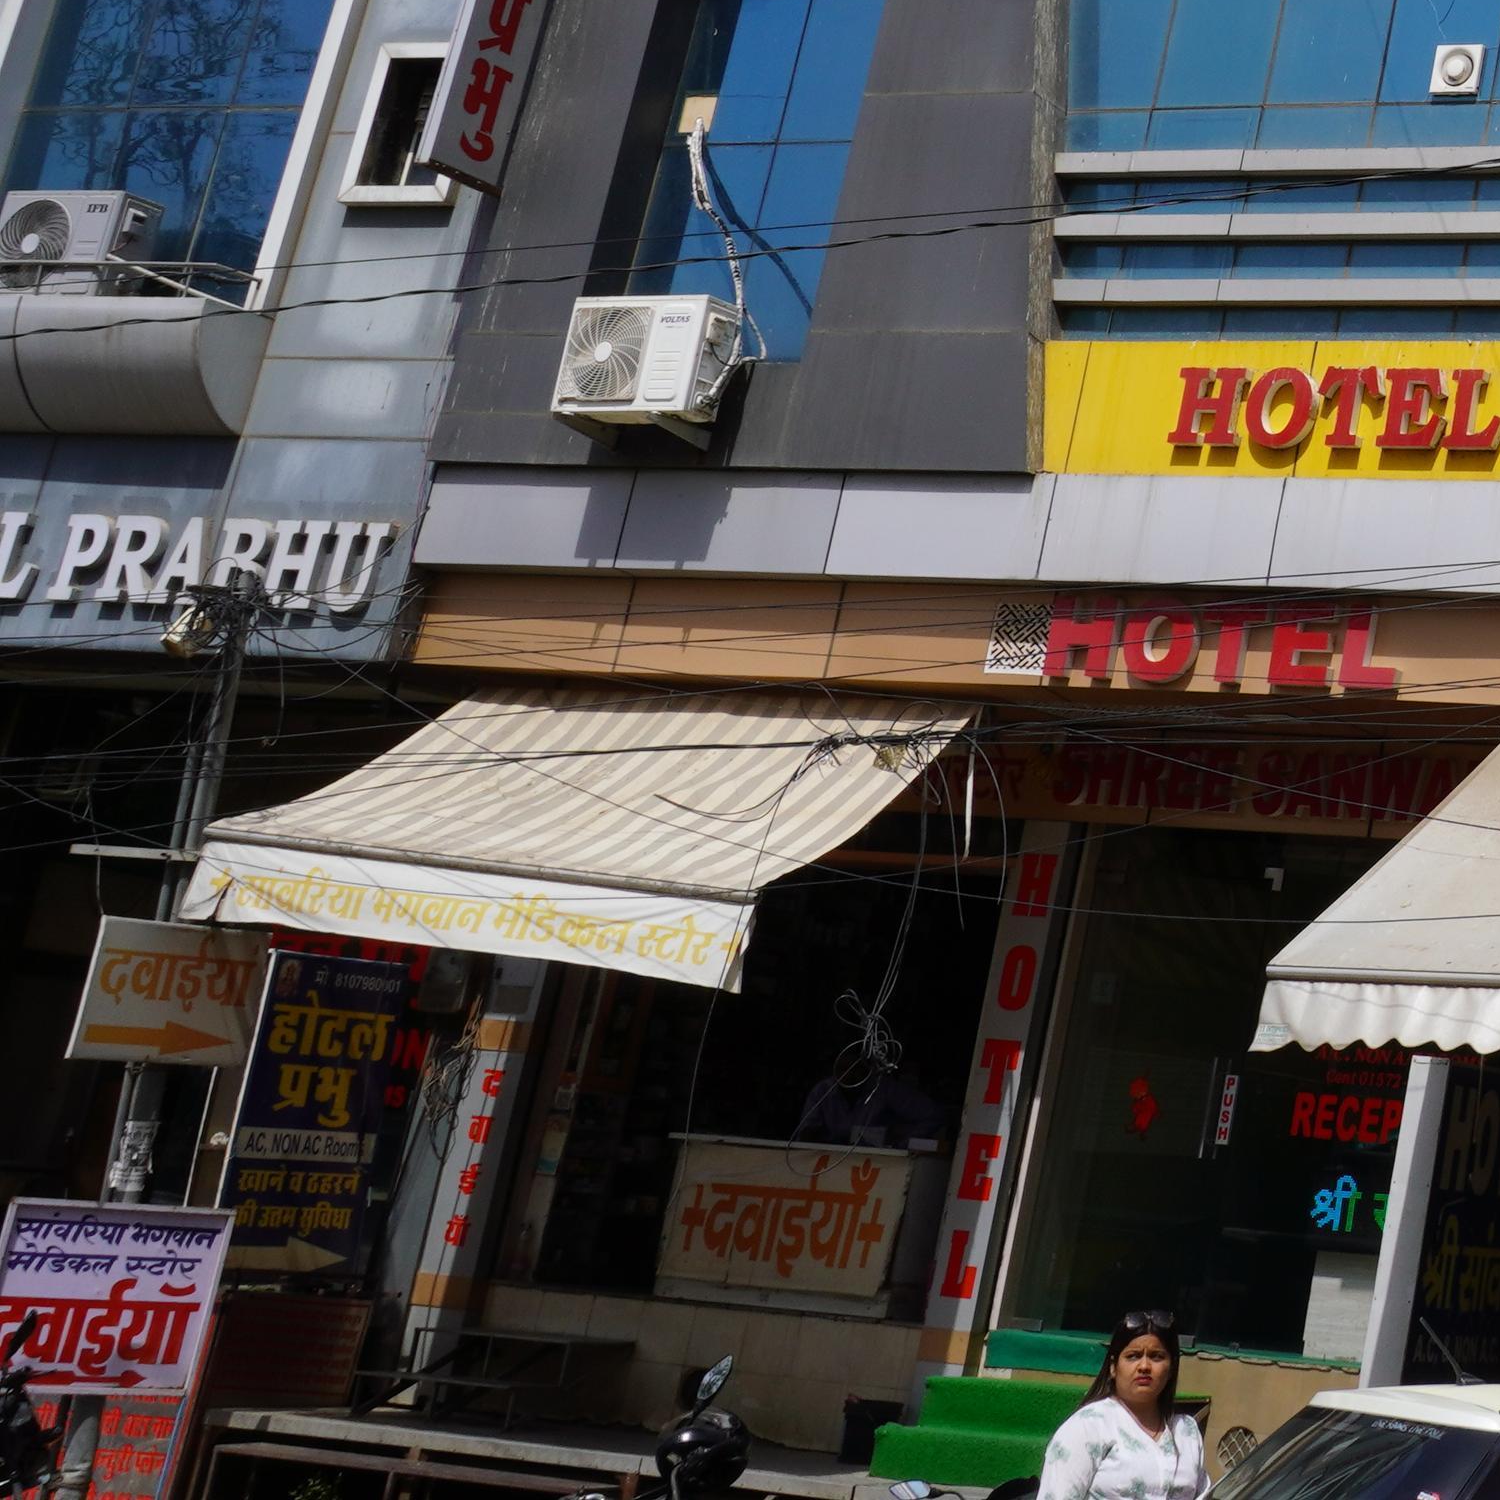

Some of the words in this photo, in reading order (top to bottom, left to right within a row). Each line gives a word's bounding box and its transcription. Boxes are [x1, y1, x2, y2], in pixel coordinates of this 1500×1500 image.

[86, 203, 109, 213] IFB
[660, 315, 691, 323] VOLTAS
[50, 513, 396, 612] PRABHU
[1042, 593, 1399, 691] HOTEL
[1052, 742, 1248, 816] SHREE
[1252, 748, 1490, 822] SANWA
[373, 886, 493, 936] भगवान
[635, 913, 718, 966] स्टोर
[267, 989, 397, 1062] होटल
[271, 1062, 358, 1130] प्रभु
[940, 853, 1059, 1300] HOTEL
[1215, 1077, 1237, 1141] PUSH
[270, 1133, 301, 1154] NON
[302, 1135, 322, 1156] AC
[16, 1212, 130, 1249] सांवरिया
[131, 1221, 223, 1251] भगवान
[1310, 1173, 1363, 1233] श्री
[7, 1243, 118, 1276] मेडिकल
[126, 1249, 202, 1281] स्टोर
[1422, 1213, 1462, 1311] श्री
